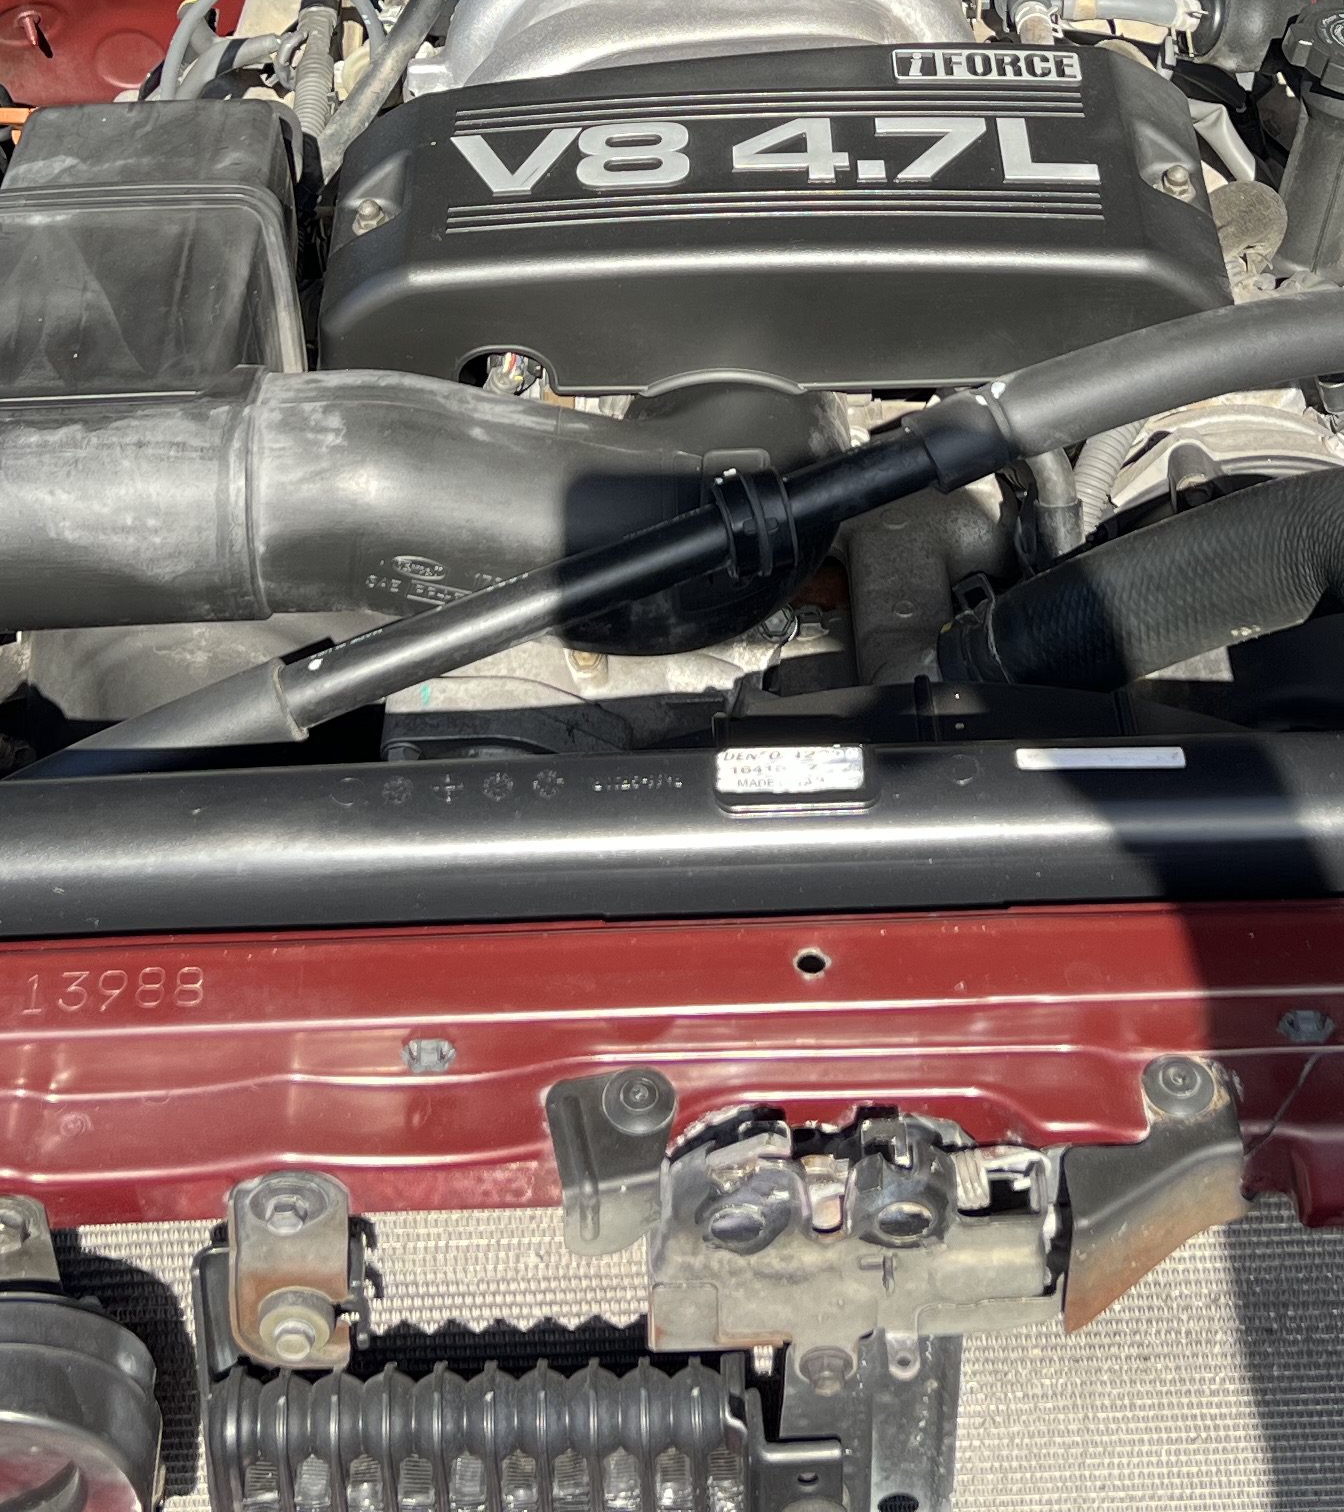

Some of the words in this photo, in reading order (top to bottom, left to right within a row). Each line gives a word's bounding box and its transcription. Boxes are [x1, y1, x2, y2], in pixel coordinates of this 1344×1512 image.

[941, 52, 1078, 79] FORCE
[450, 120, 691, 196] V8
[731, 117, 1101, 185] 4.7L
[723, 750, 782, 762] DENO
[21, 965, 204, 1015] 13988
